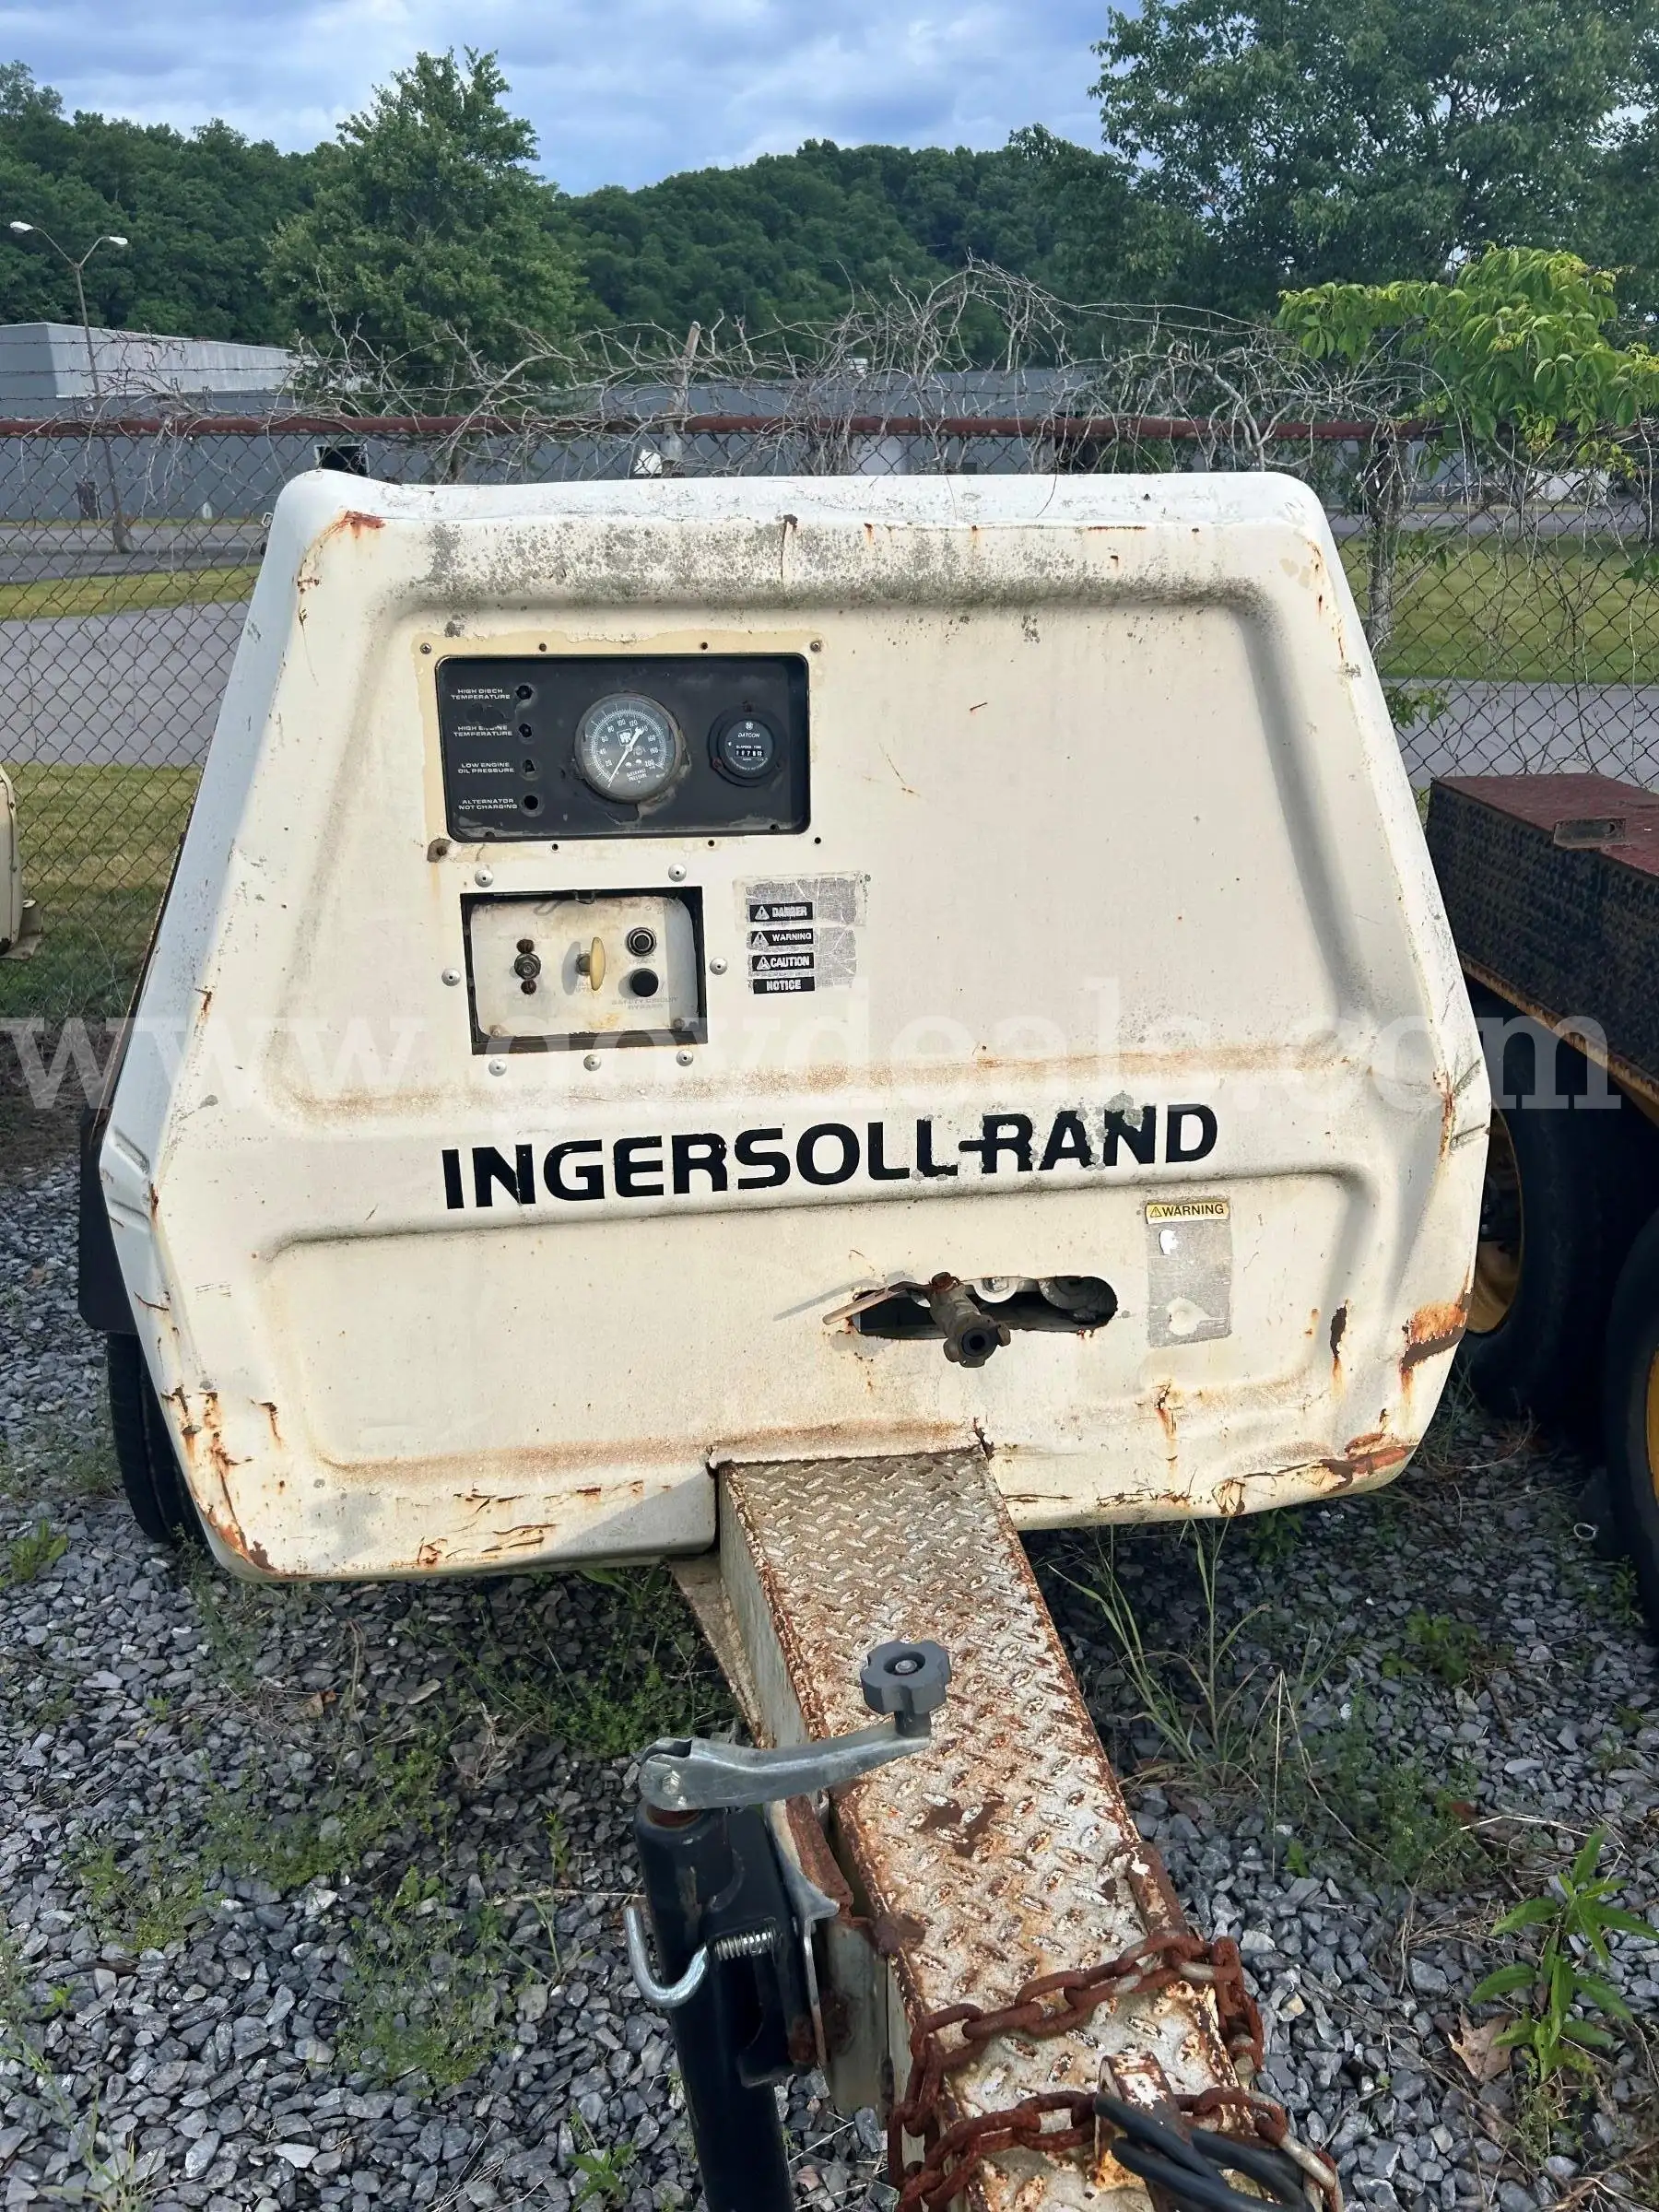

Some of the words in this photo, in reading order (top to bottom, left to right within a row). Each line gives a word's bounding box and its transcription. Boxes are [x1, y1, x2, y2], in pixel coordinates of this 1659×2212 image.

[771, 906, 807, 918] DANGER
[771, 933, 812, 942] WARNING
[770, 956, 810, 968] CAUTION
[766, 979, 802, 992] NOTICE
[441, 1103, 1218, 1209] INGERSOLL-RAND
[1161, 1204, 1224, 1217] WARNING
